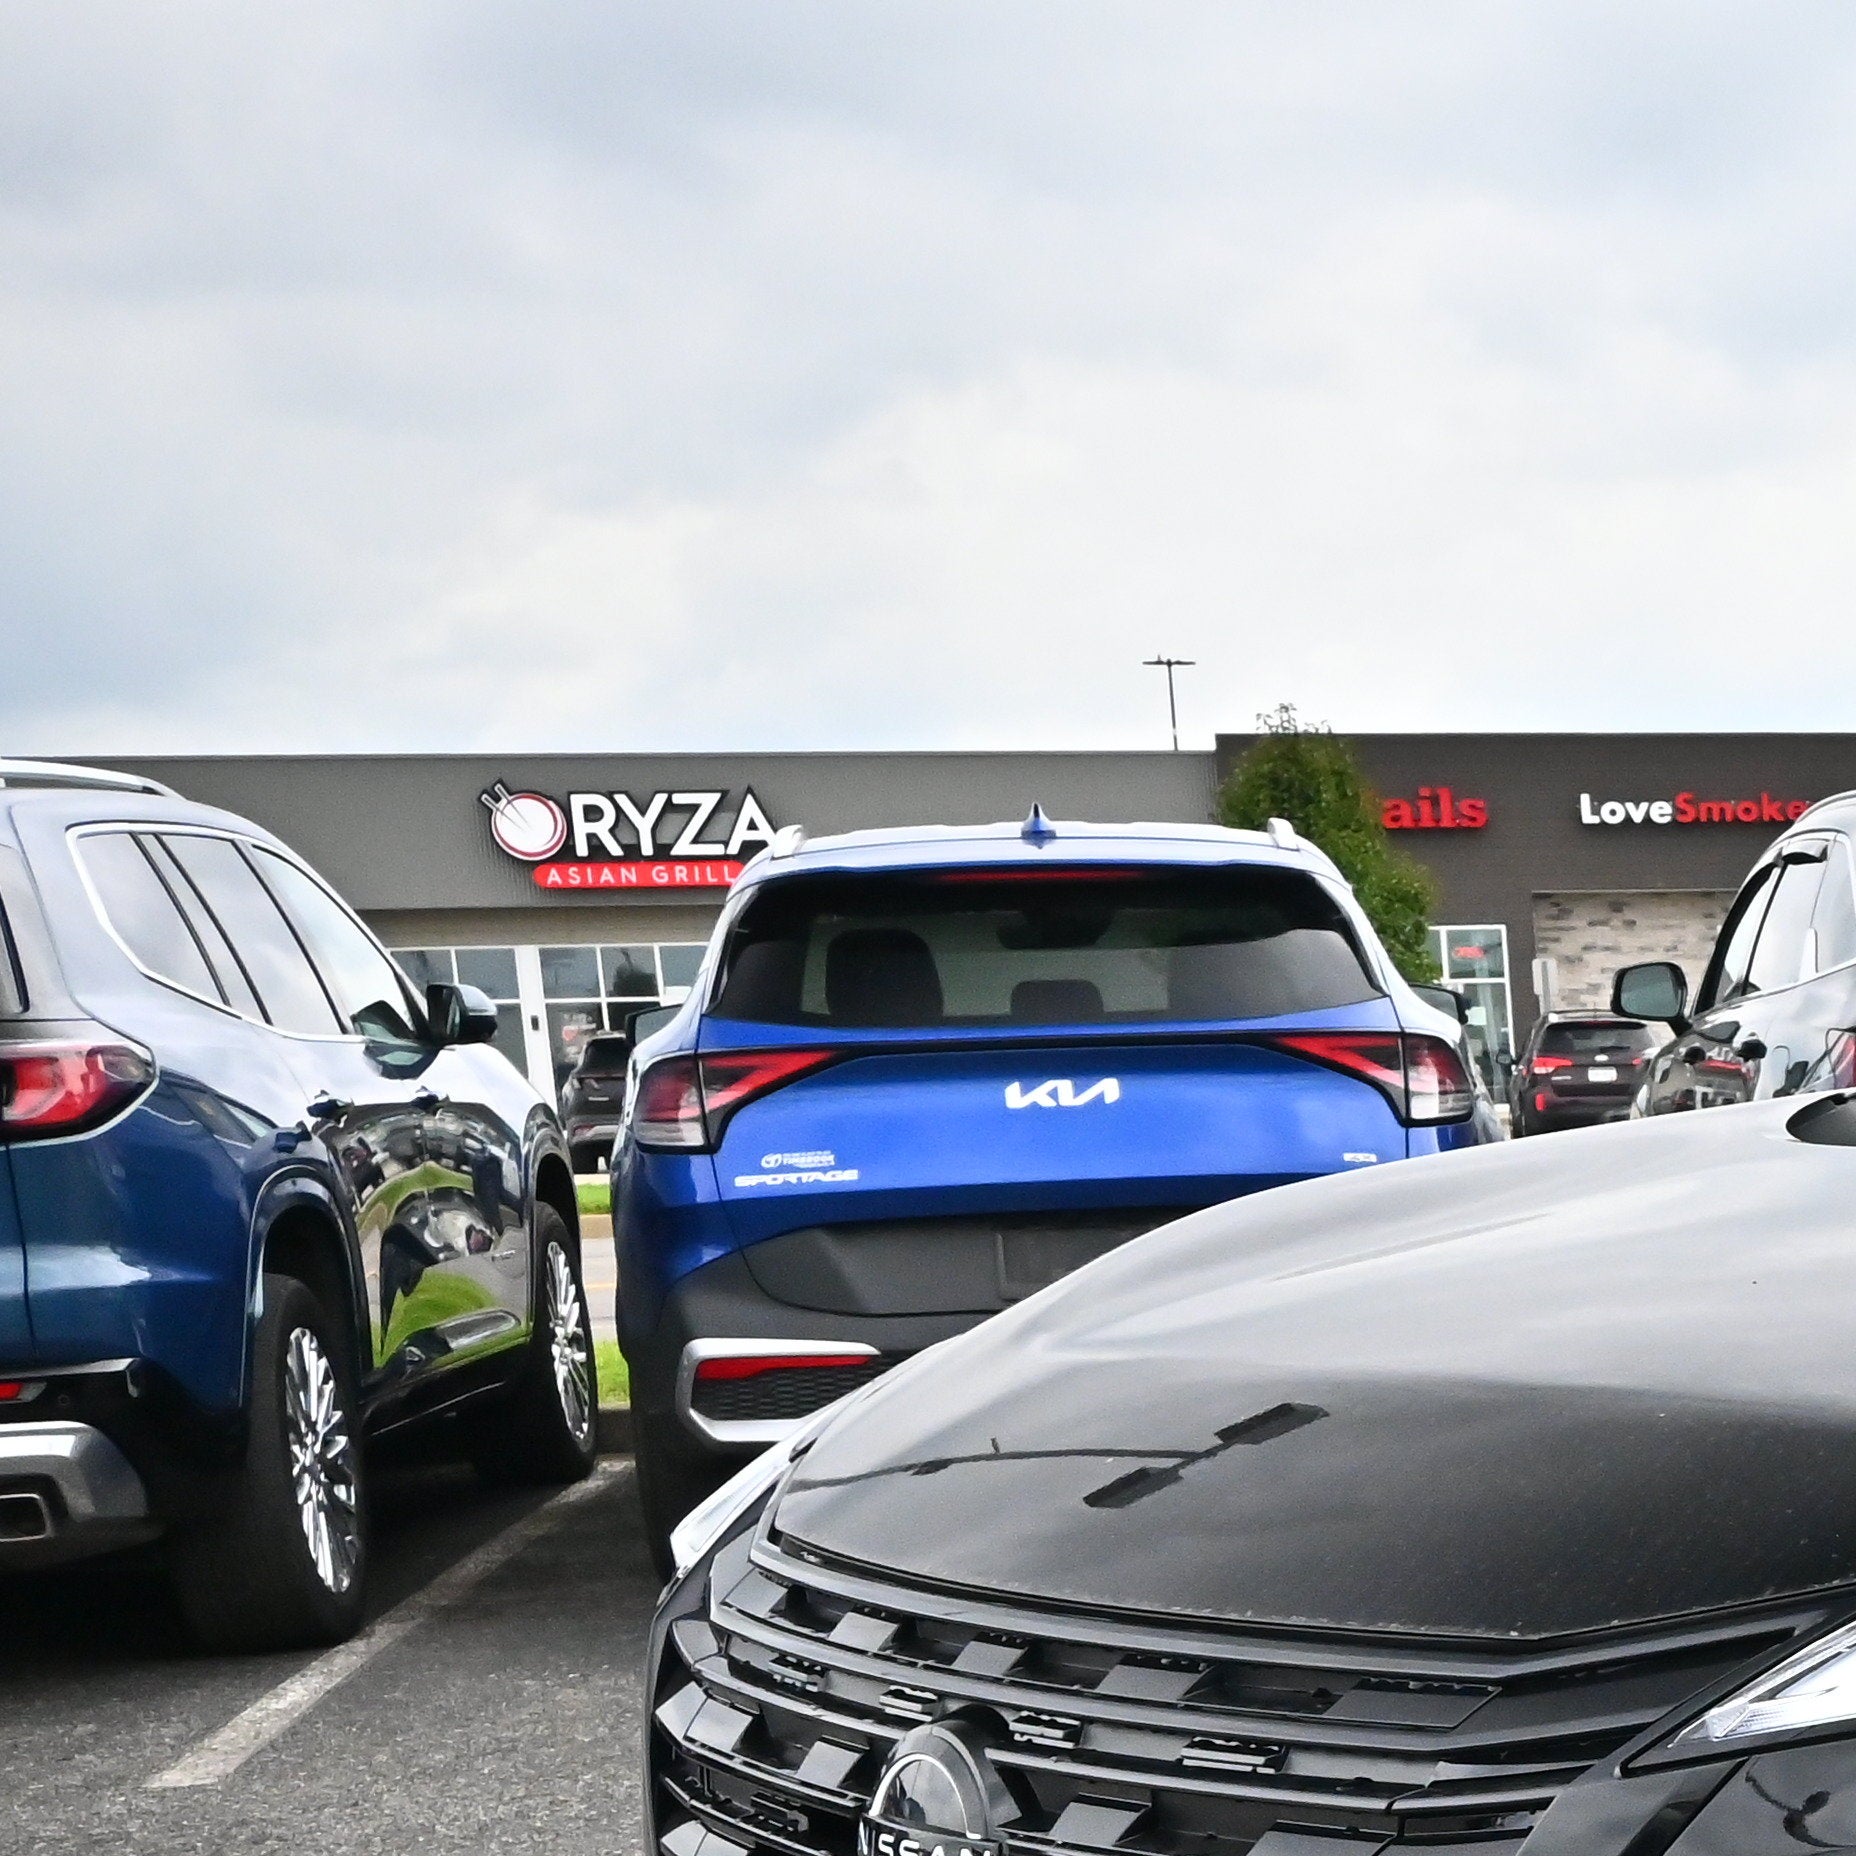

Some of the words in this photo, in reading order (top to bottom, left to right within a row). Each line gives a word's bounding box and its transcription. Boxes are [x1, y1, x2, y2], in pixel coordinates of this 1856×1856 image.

[1381, 787, 1488, 829] ails
[546, 866, 638, 885] ASIAN
[652, 865, 737, 883] GRILL
[1004, 1077, 1120, 1109] KIA
[734, 1169, 859, 1187] SPORTAGE
